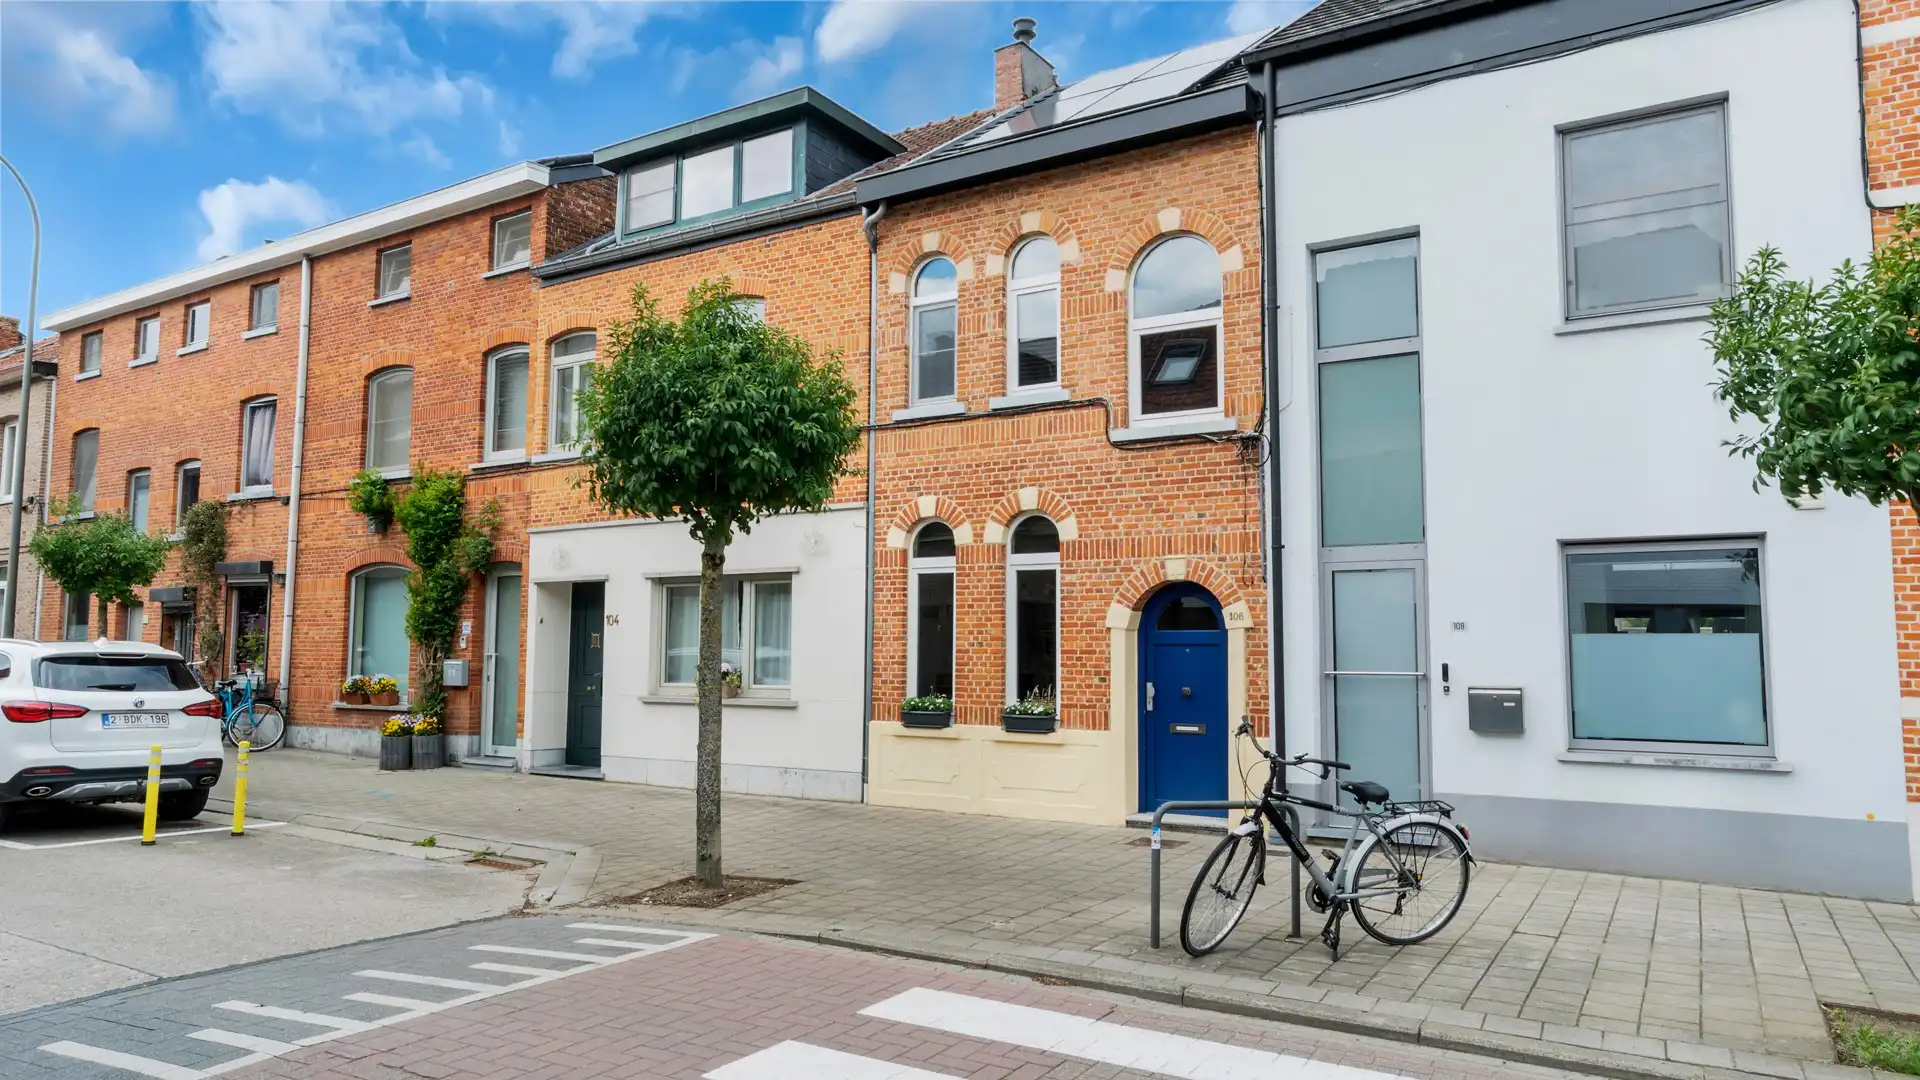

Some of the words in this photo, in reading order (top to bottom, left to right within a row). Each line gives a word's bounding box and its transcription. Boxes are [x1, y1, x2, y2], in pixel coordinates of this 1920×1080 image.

[606, 614, 620, 626] 104
[1229, 611, 1244, 621] 106
[1453, 621, 1465, 631] 108
